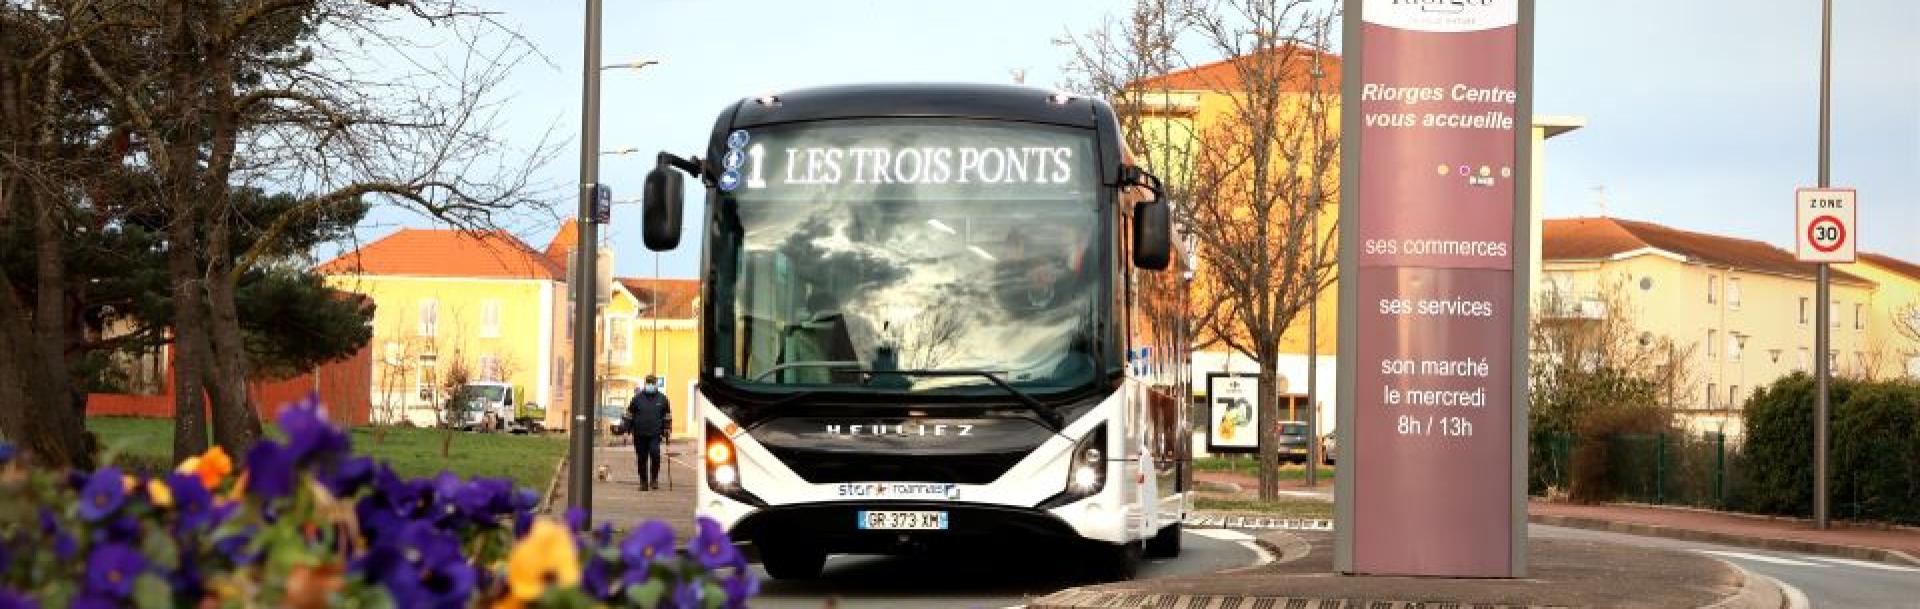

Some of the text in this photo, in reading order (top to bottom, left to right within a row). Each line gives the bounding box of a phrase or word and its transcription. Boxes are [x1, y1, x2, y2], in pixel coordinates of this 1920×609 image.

[1361, 83, 1517, 105] Riorges Centre
[1365, 112, 1513, 130] vous accueille
[747, 143, 1072, 188] 1 LES TROIS PONTS
[1810, 199, 1843, 208] ZONE
[1816, 226, 1838, 241] 30
[1365, 239, 1507, 257] ses commerces
[1379, 296, 1493, 317] ses services
[1381, 357, 1489, 377] son marché
[1383, 385, 1486, 407] le mercredi
[826, 424, 974, 436] HEULIEZ
[1397, 415, 1473, 437] 8h / 13h
